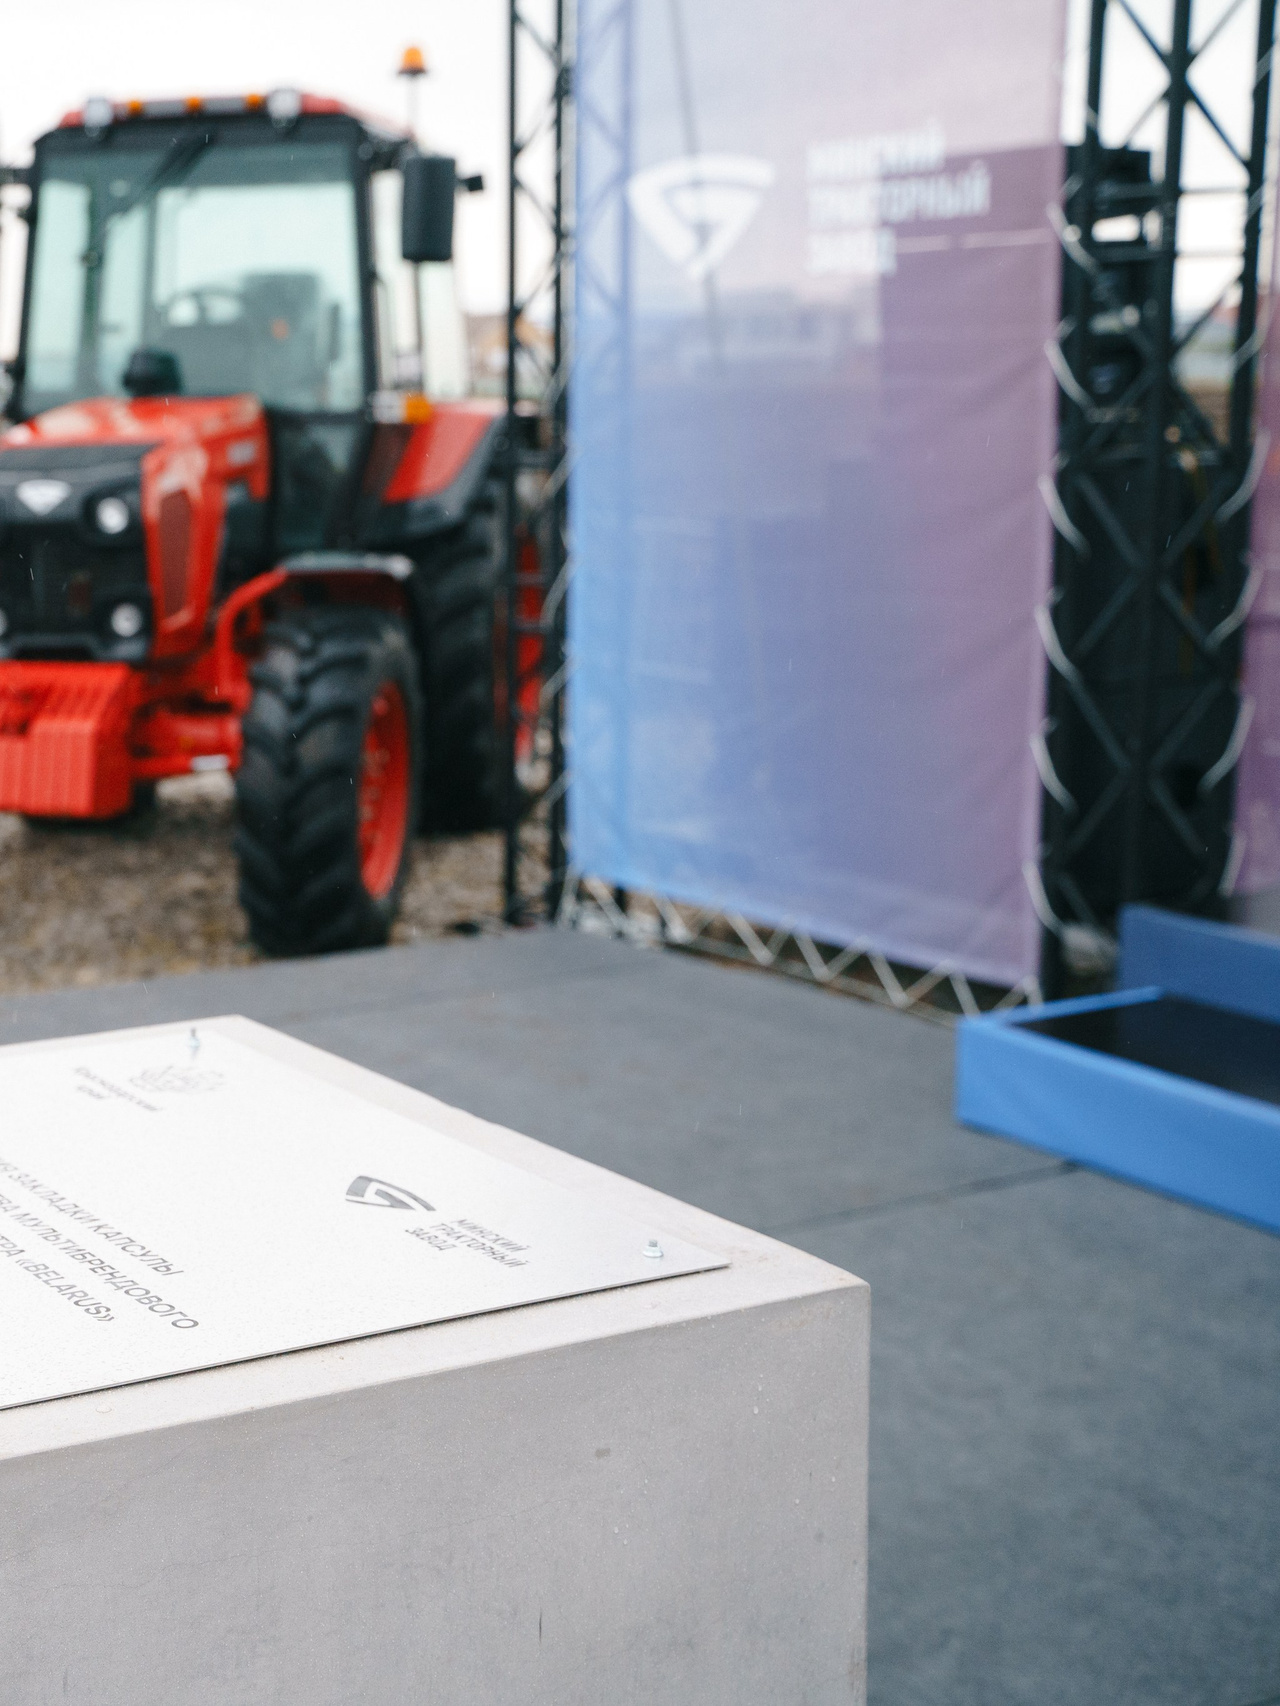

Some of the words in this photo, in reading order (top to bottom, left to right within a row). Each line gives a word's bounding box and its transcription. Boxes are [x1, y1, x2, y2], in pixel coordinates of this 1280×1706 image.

[9, 1172, 100, 1225] ЗАКЛАДКИ
[88, 1223, 184, 1276] КАПСУЛЫ
[405, 1226, 457, 1252] ЗАВОД
[430, 1222, 530, 1268] ТРАКТОРНЫЙ
[451, 1218, 531, 1253] МИНСКИЙ
[10, 1212, 199, 1329] МУЛЬТИБРЕНДОВОГО
[15, 1258, 115, 1322] «BELARUS»
